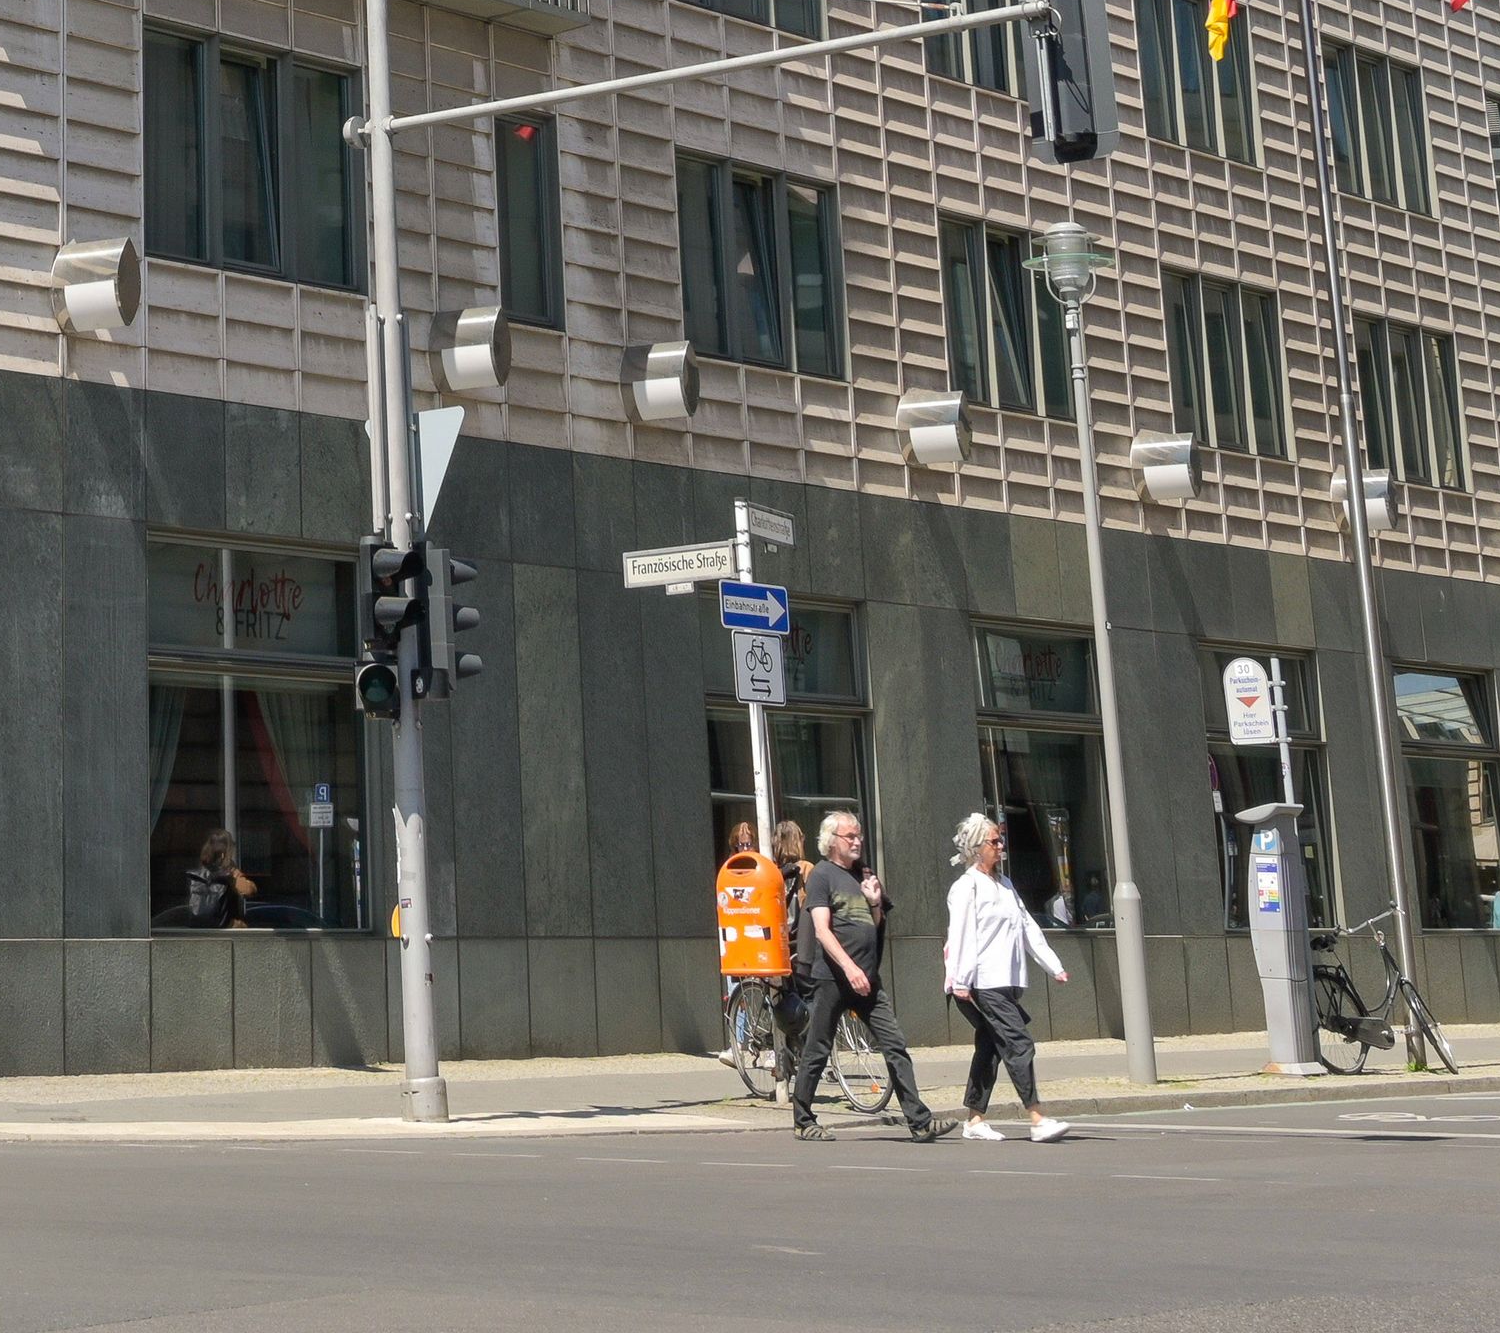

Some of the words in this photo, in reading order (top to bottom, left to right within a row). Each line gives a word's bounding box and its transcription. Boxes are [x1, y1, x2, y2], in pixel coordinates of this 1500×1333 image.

[632, 559, 694, 576] Französische
[697, 551, 728, 572] Straße
[725, 598, 769, 614] Einbahnstraße
[235, 609, 287, 640] FRITZ
[1236, 664, 1250, 674] 30
